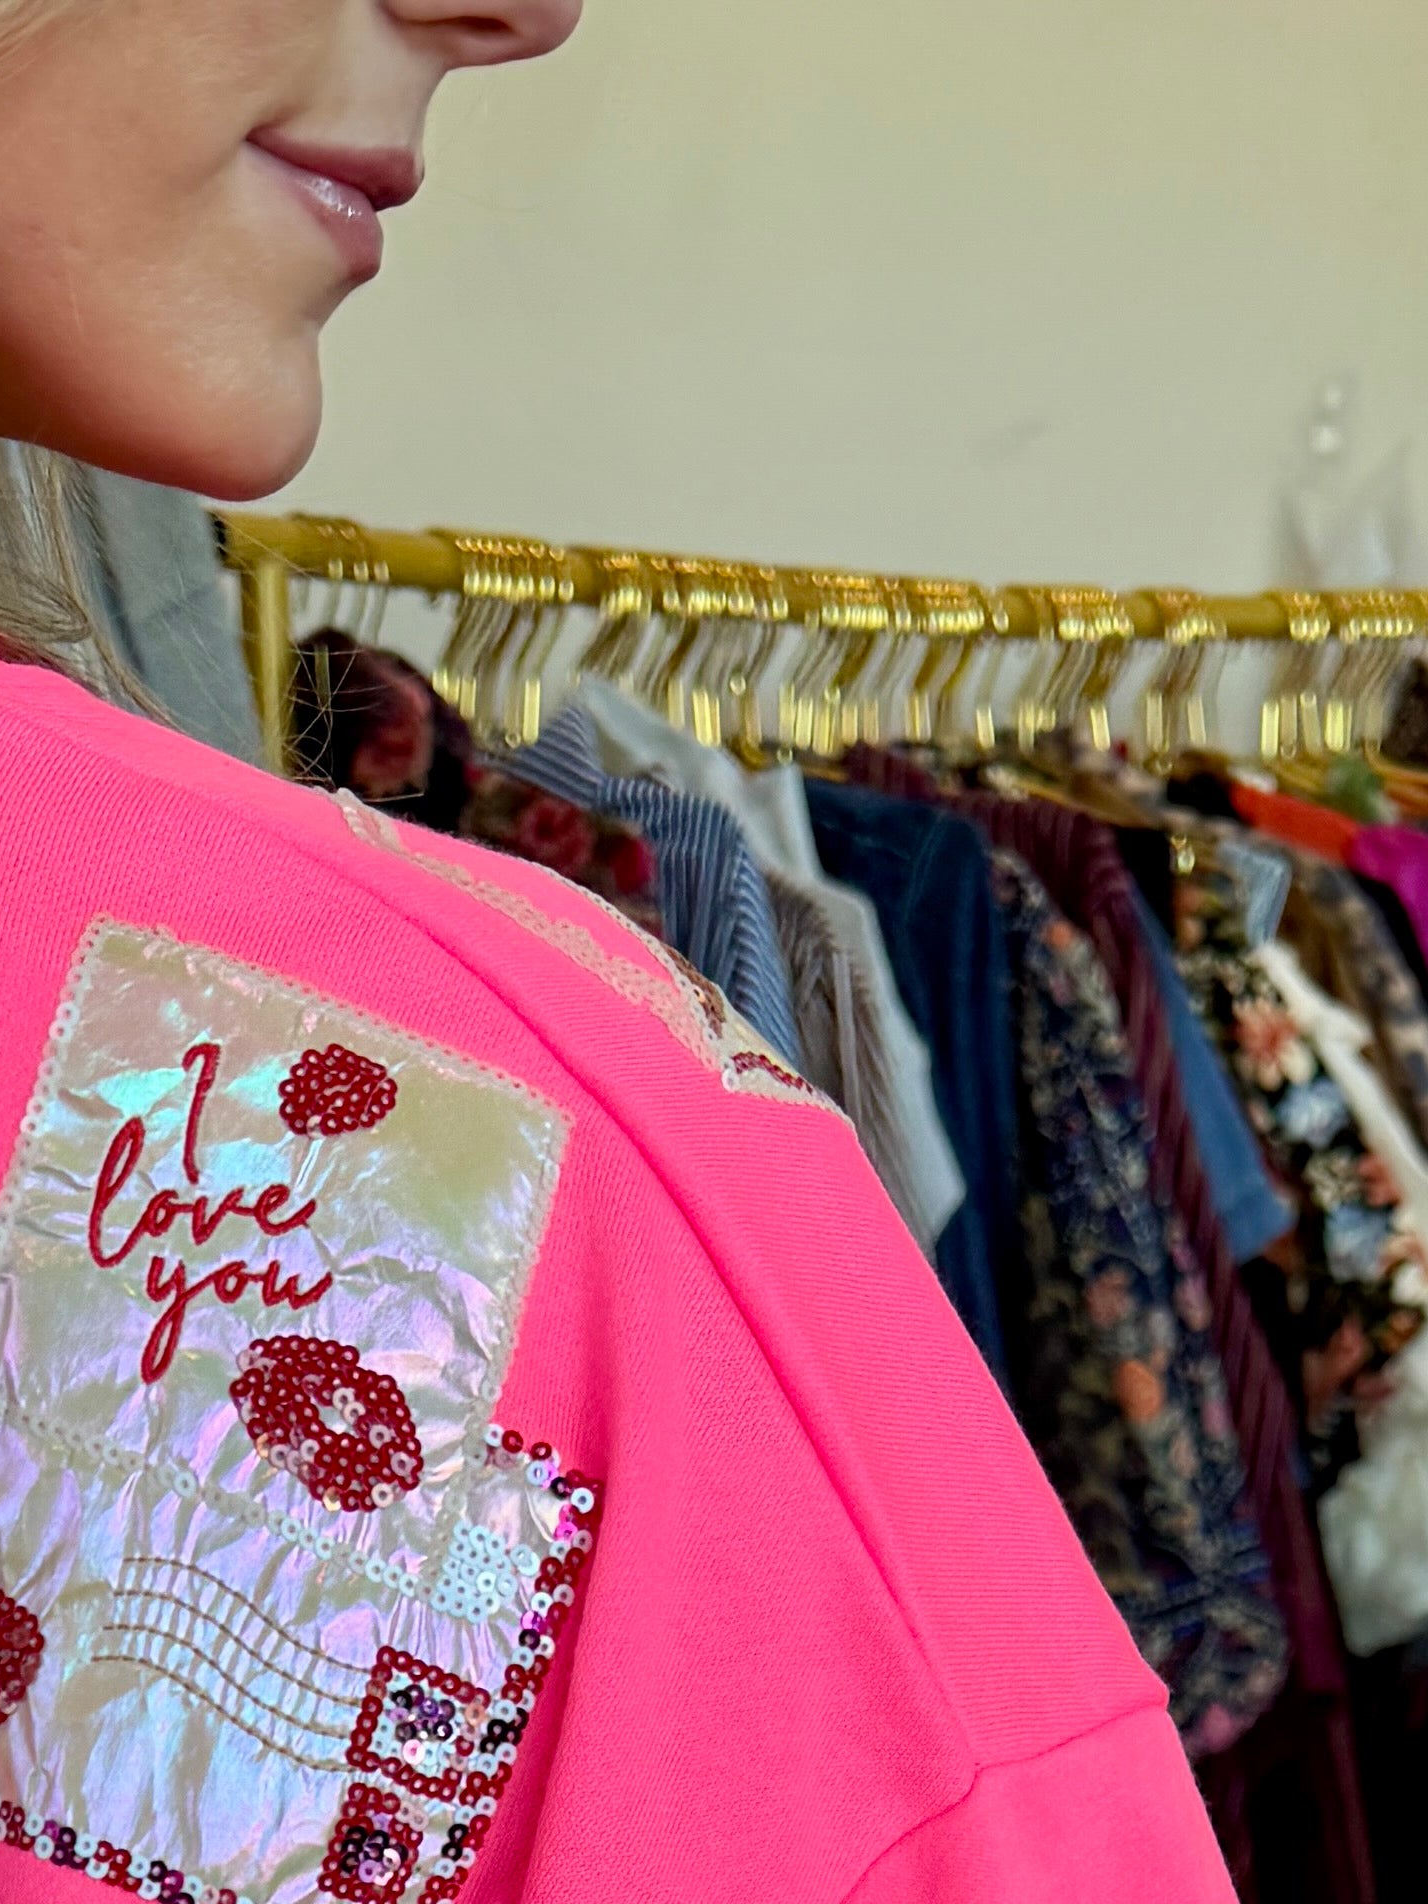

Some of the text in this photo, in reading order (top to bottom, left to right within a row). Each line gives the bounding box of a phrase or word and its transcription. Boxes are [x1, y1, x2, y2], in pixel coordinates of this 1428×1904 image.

[181, 1042, 221, 1184] I
[87, 1116, 318, 1269] love
[139, 1250, 333, 1385] you
